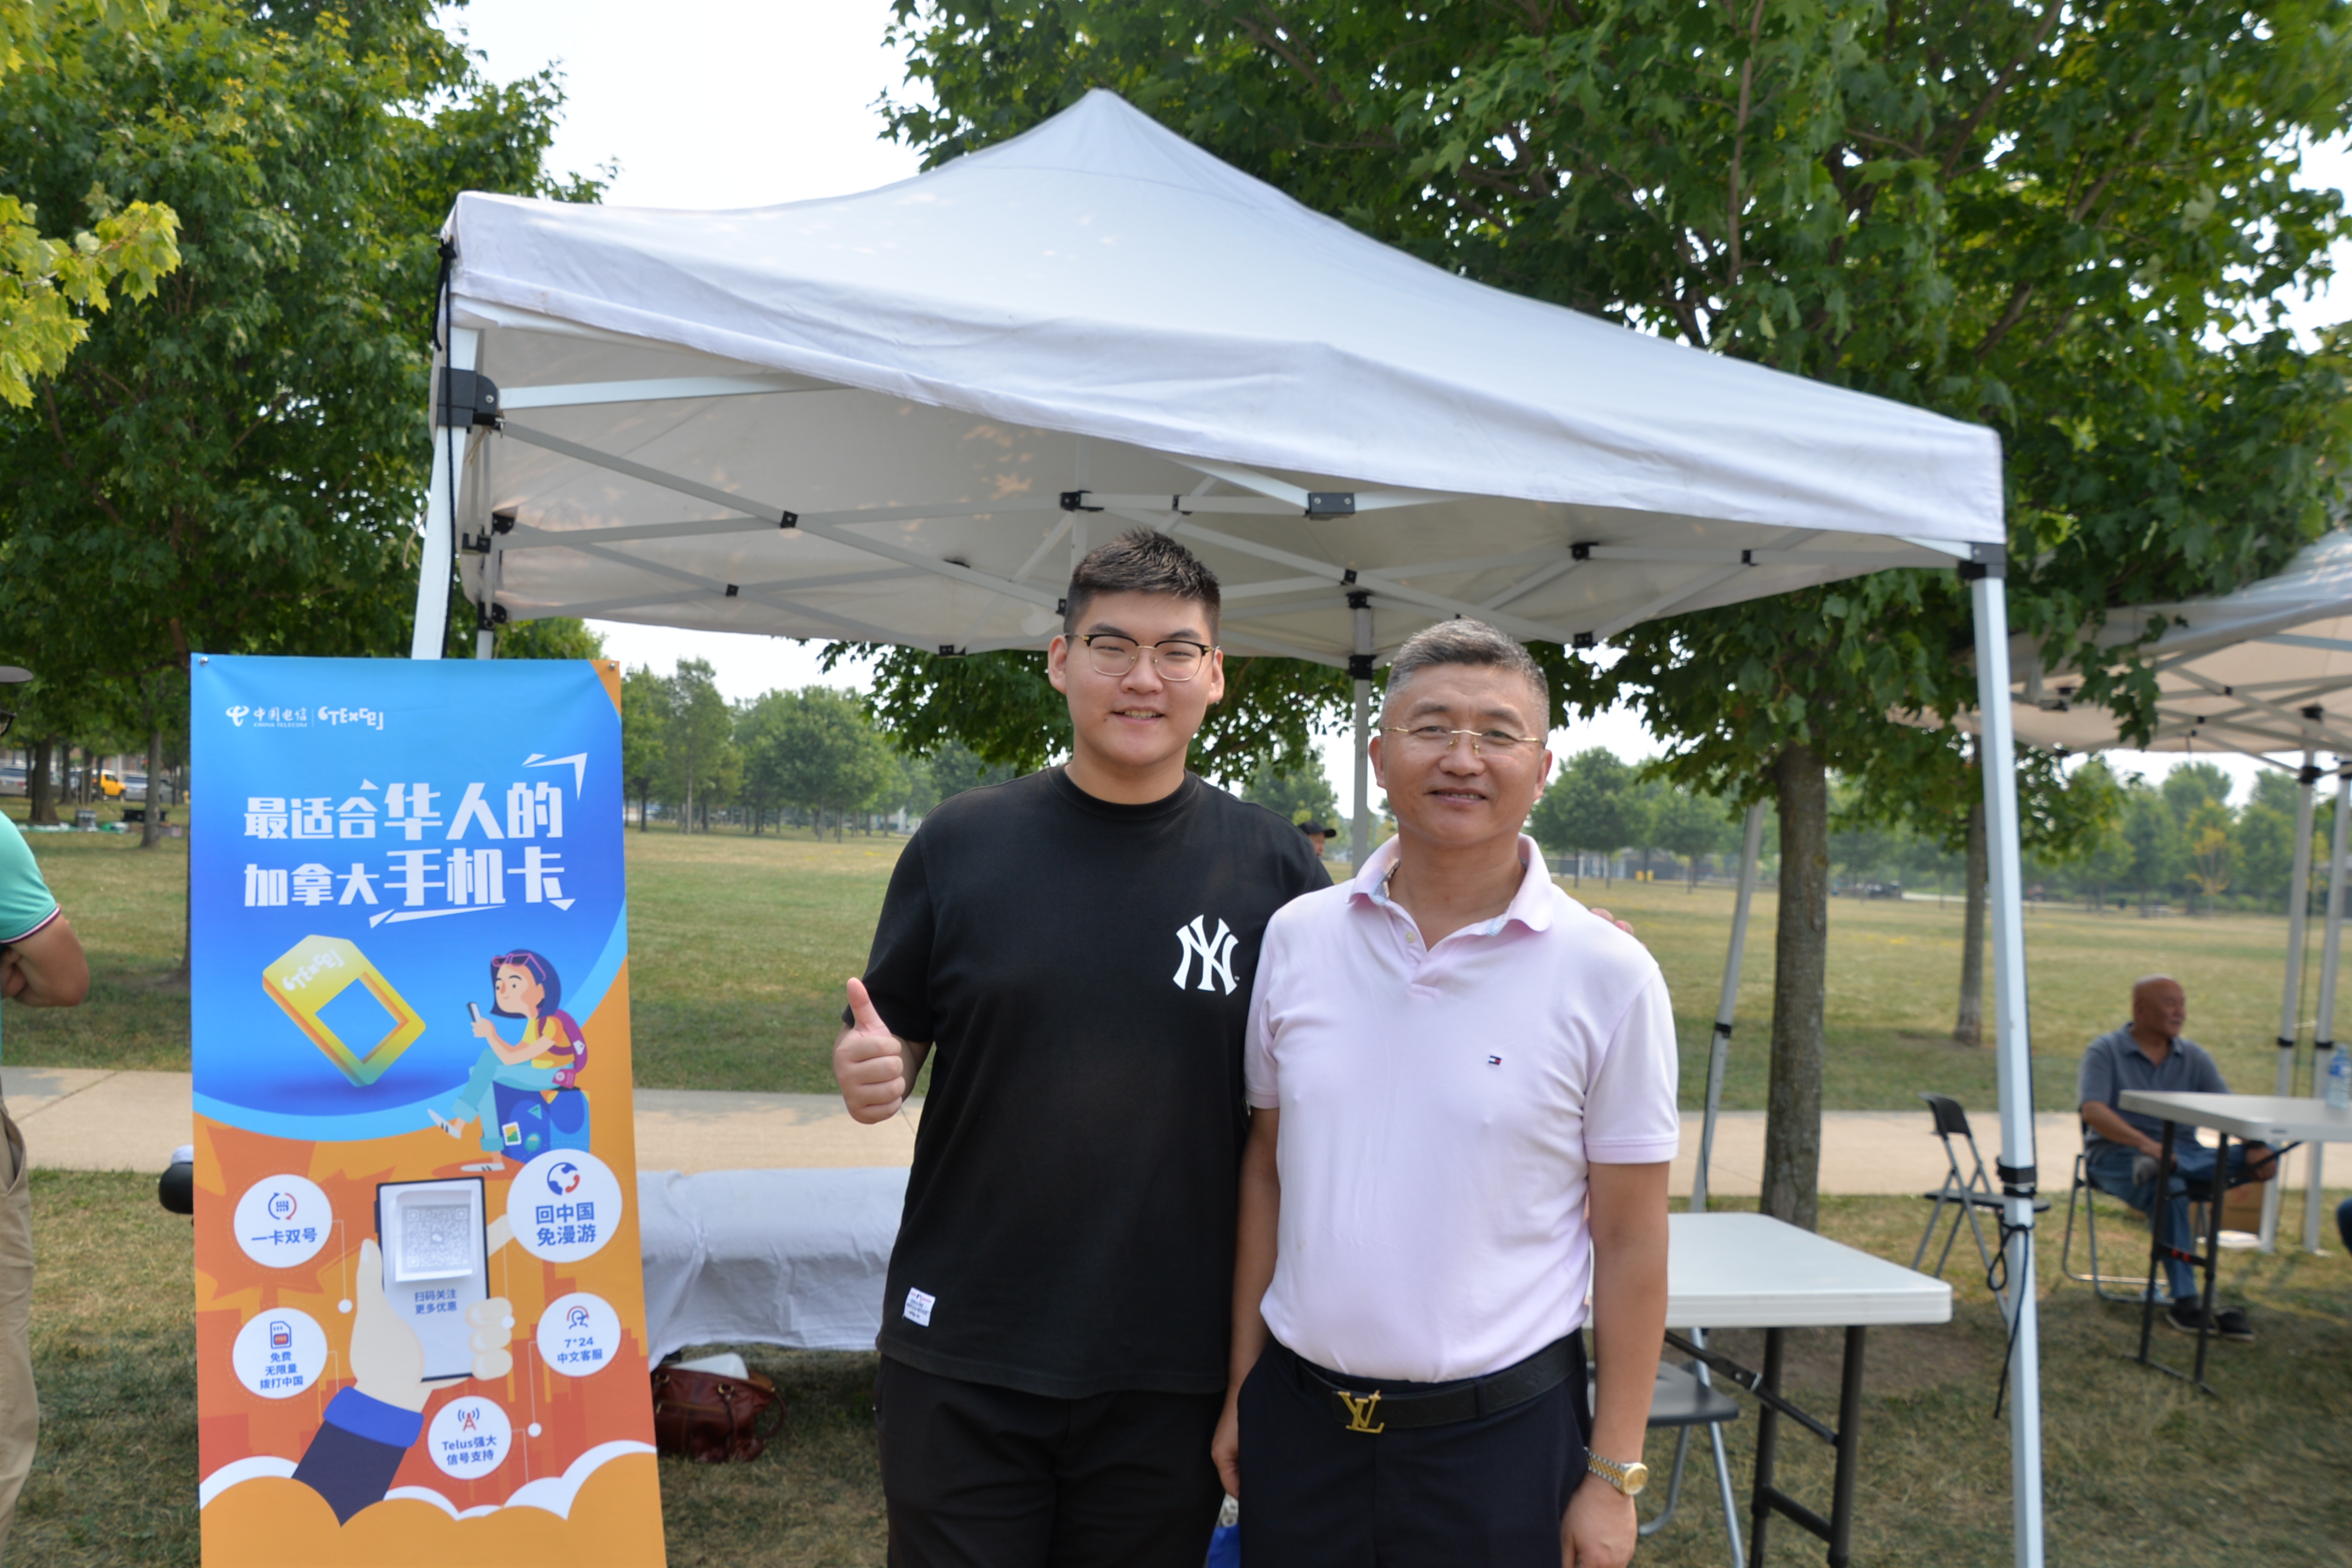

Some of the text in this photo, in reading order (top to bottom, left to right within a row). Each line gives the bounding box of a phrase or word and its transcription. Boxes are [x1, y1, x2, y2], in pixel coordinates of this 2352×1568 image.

[253, 706, 307, 722] 中国电信
[244, 782, 563, 841] 最适合华人的
[244, 846, 565, 906] 加拿大手机卡
[1172, 914, 1239, 996] NY
[535, 1202, 595, 1224] 回中国
[251, 1227, 318, 1245] 一卡双号
[537, 1226, 597, 1247] 免漫游
[415, 1288, 457, 1302] 扫码关注
[415, 1301, 457, 1315] 更多优惠
[271, 1351, 292, 1363] 免费
[558, 1348, 603, 1364] 中文客服
[265, 1363, 298, 1376] 无限量
[260, 1376, 304, 1390] 拨打中国
[447, 1449, 494, 1466] 信号支持
